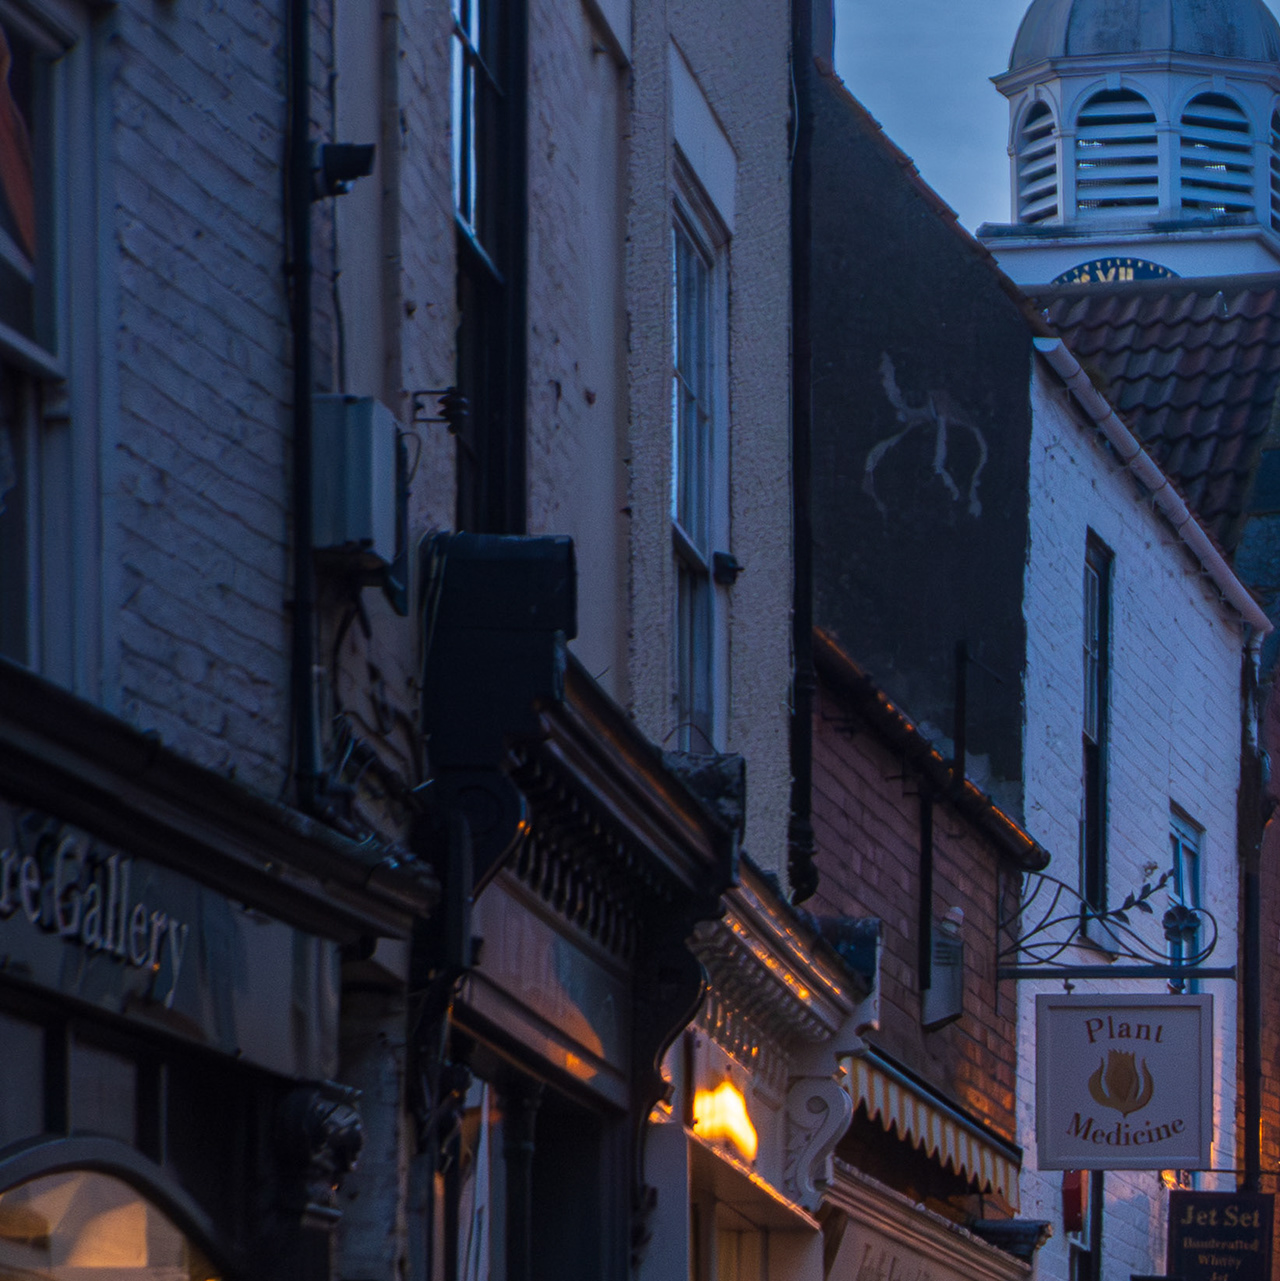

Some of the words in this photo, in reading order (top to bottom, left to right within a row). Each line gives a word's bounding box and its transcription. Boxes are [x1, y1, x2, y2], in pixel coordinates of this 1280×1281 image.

[53, 834, 190, 1010] Gallery
[1085, 1015, 1164, 1044] Plant
[1066, 1112, 1186, 1146] Medicine
[1181, 1204, 1218, 1227] Jet
[1223, 1204, 1260, 1228] Set
